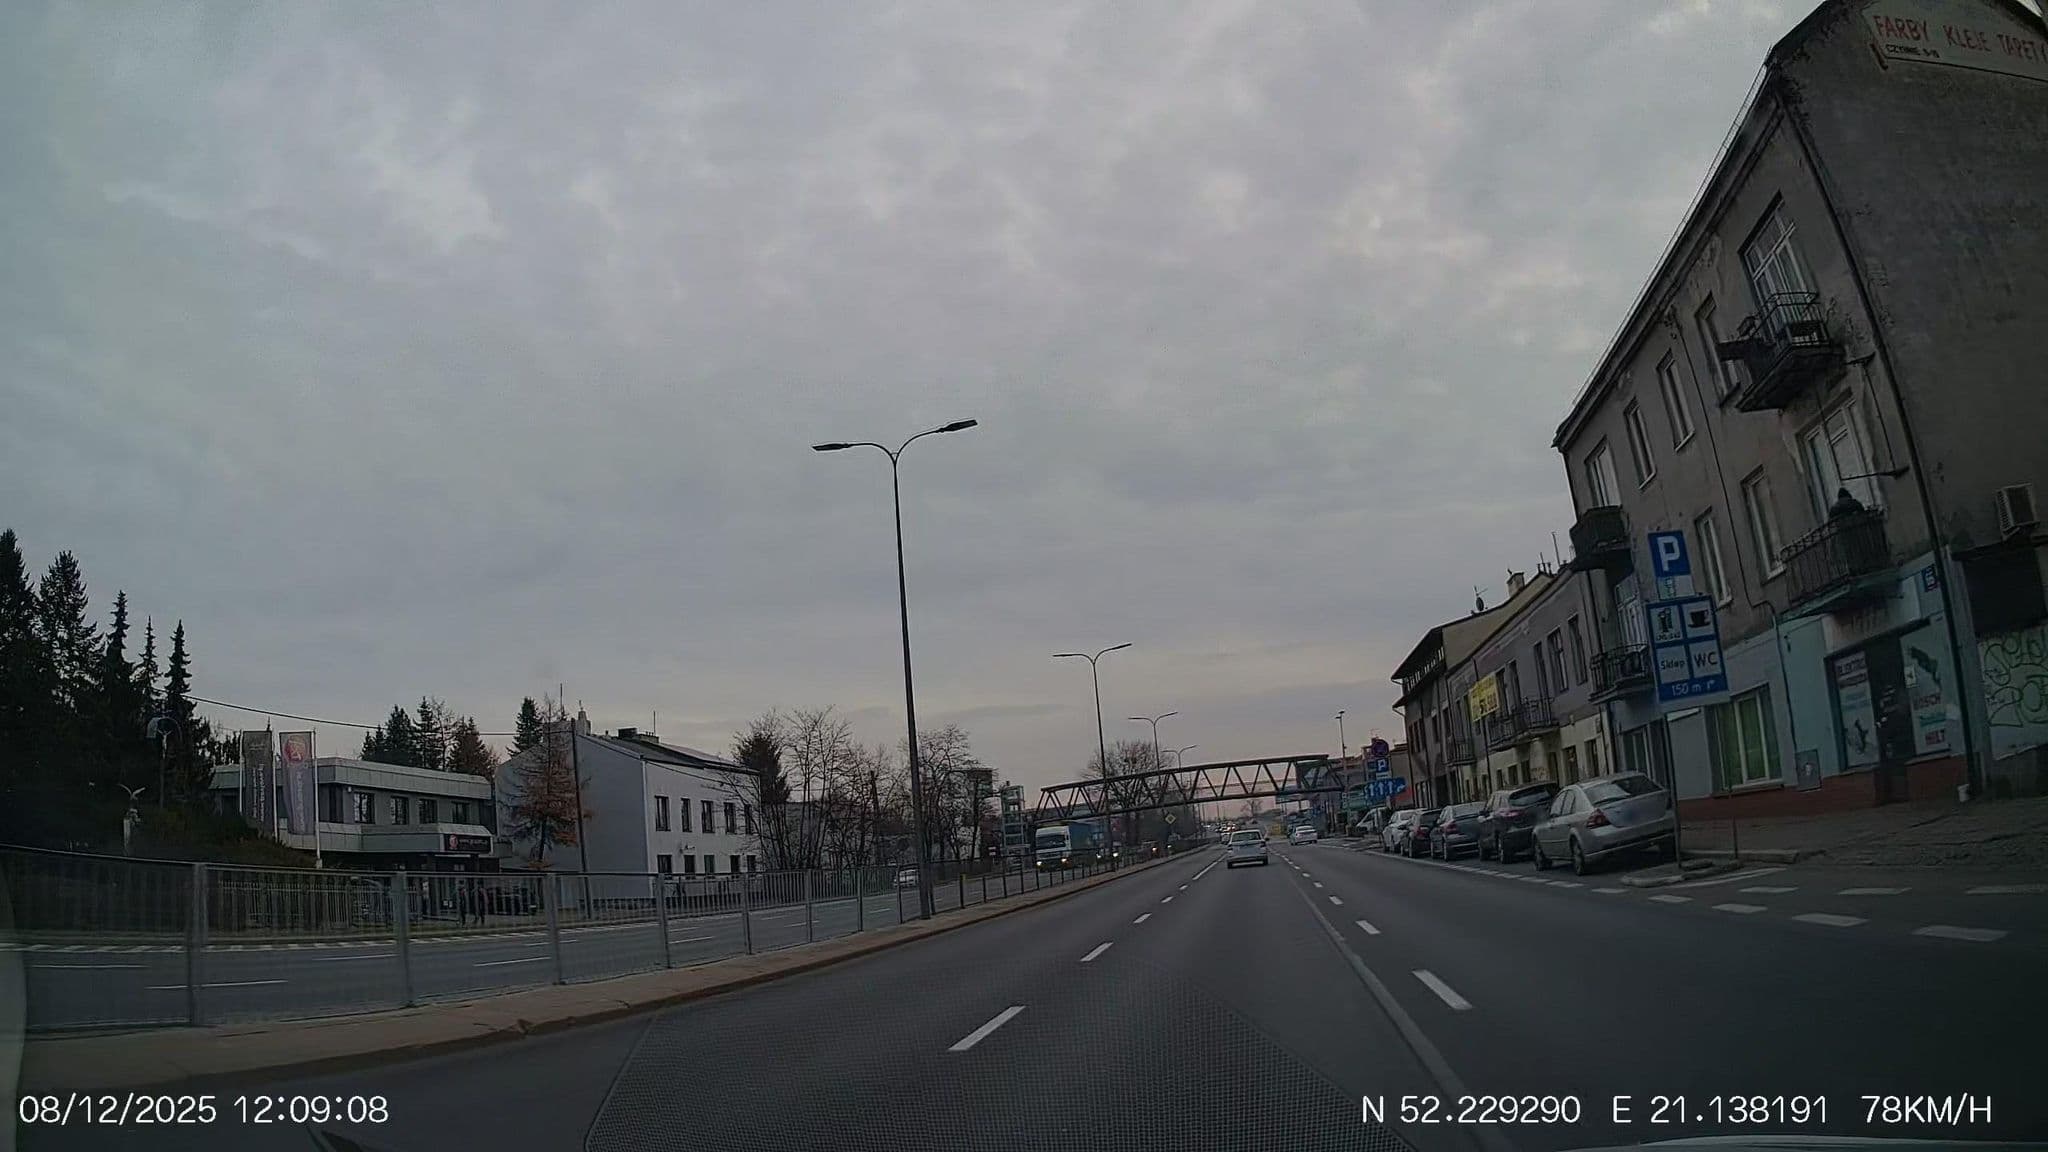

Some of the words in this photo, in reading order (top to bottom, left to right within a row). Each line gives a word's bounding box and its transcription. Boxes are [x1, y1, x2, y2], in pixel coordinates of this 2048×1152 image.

[1872, 15, 1930, 42] FARBY
[1942, 24, 1992, 52] KLEJE
[1656, 535, 1681, 572] P
[1660, 659, 1687, 670] Sklep
[1694, 651, 1718, 668] WC
[1671, 682, 1689, 697] 150
[1691, 683, 1702, 693] m
[1377, 759, 1386, 771] P
